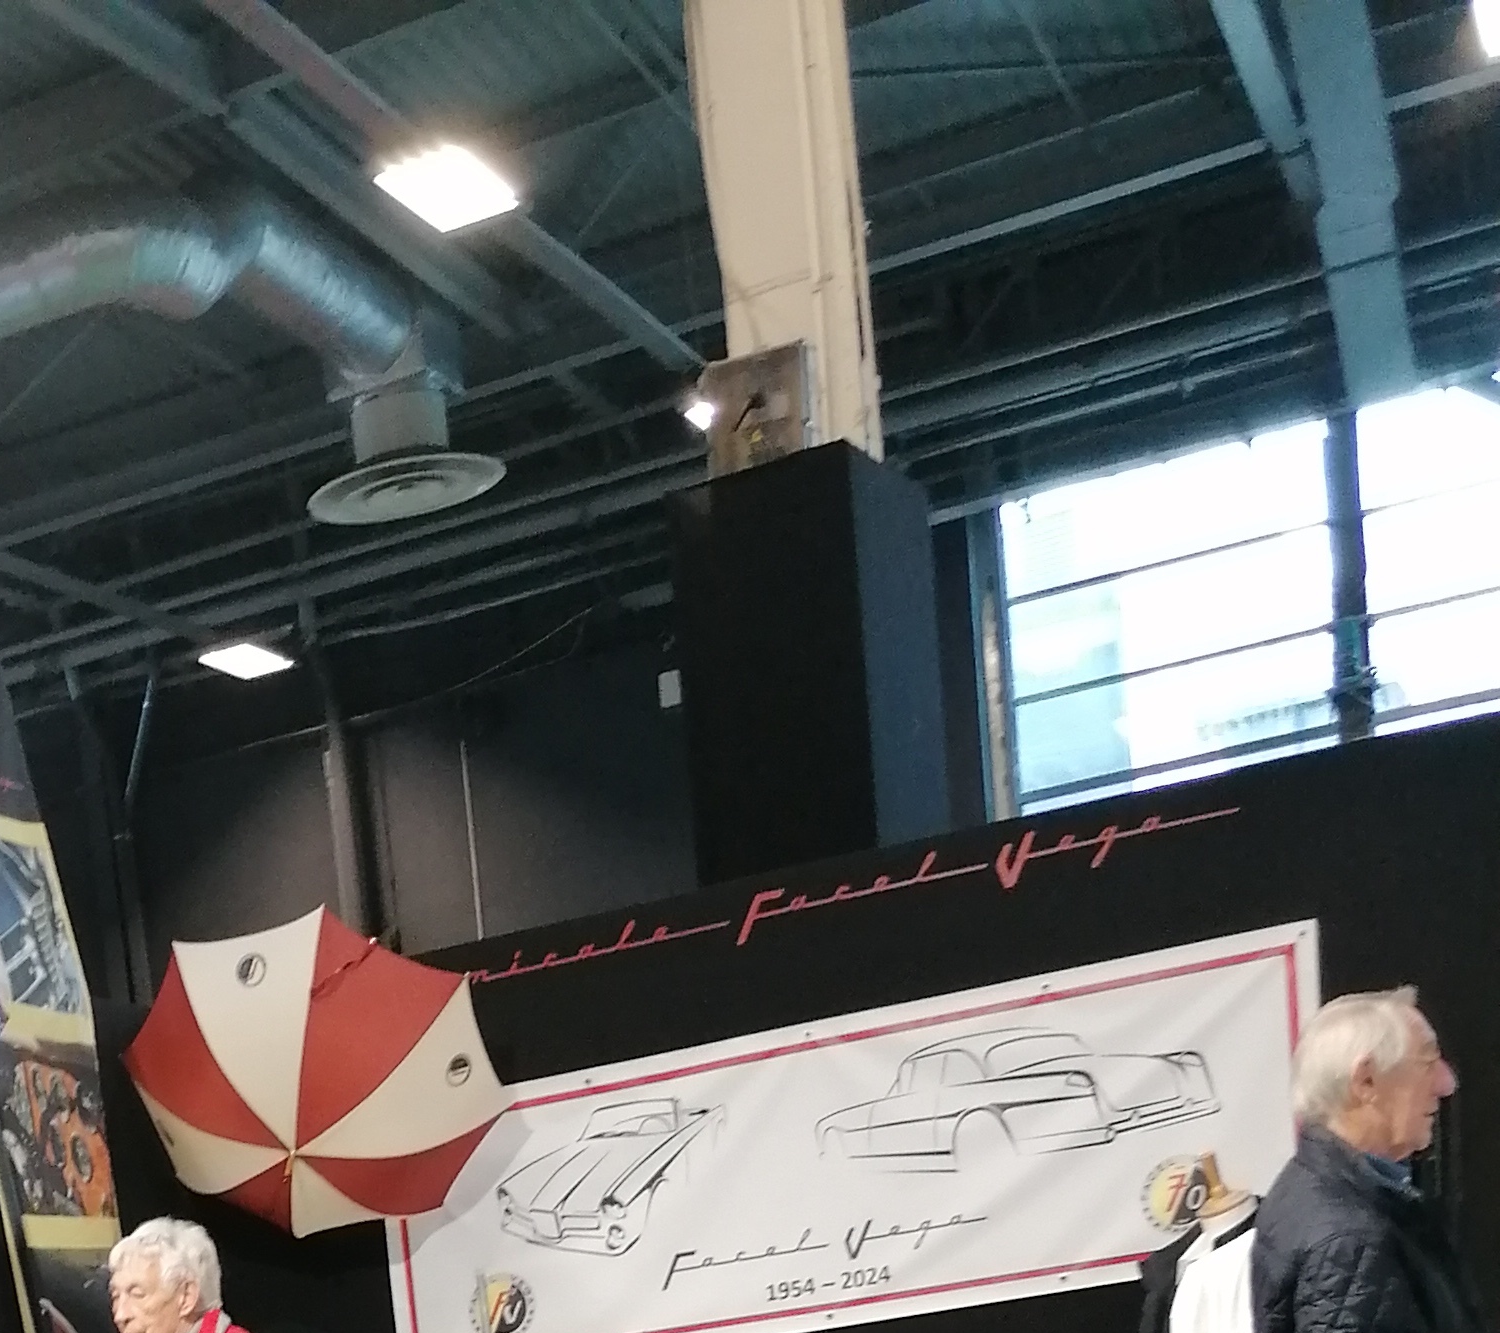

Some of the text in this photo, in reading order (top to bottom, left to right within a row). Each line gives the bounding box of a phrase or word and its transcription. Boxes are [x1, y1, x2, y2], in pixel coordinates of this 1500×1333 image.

[736, 851, 989, 945] Facel
[996, 807, 1240, 889] Vega
[662, 1214, 988, 1291] Facel Vega
[766, 1279, 816, 1302] 1954
[841, 1264, 891, 1291] 2024
